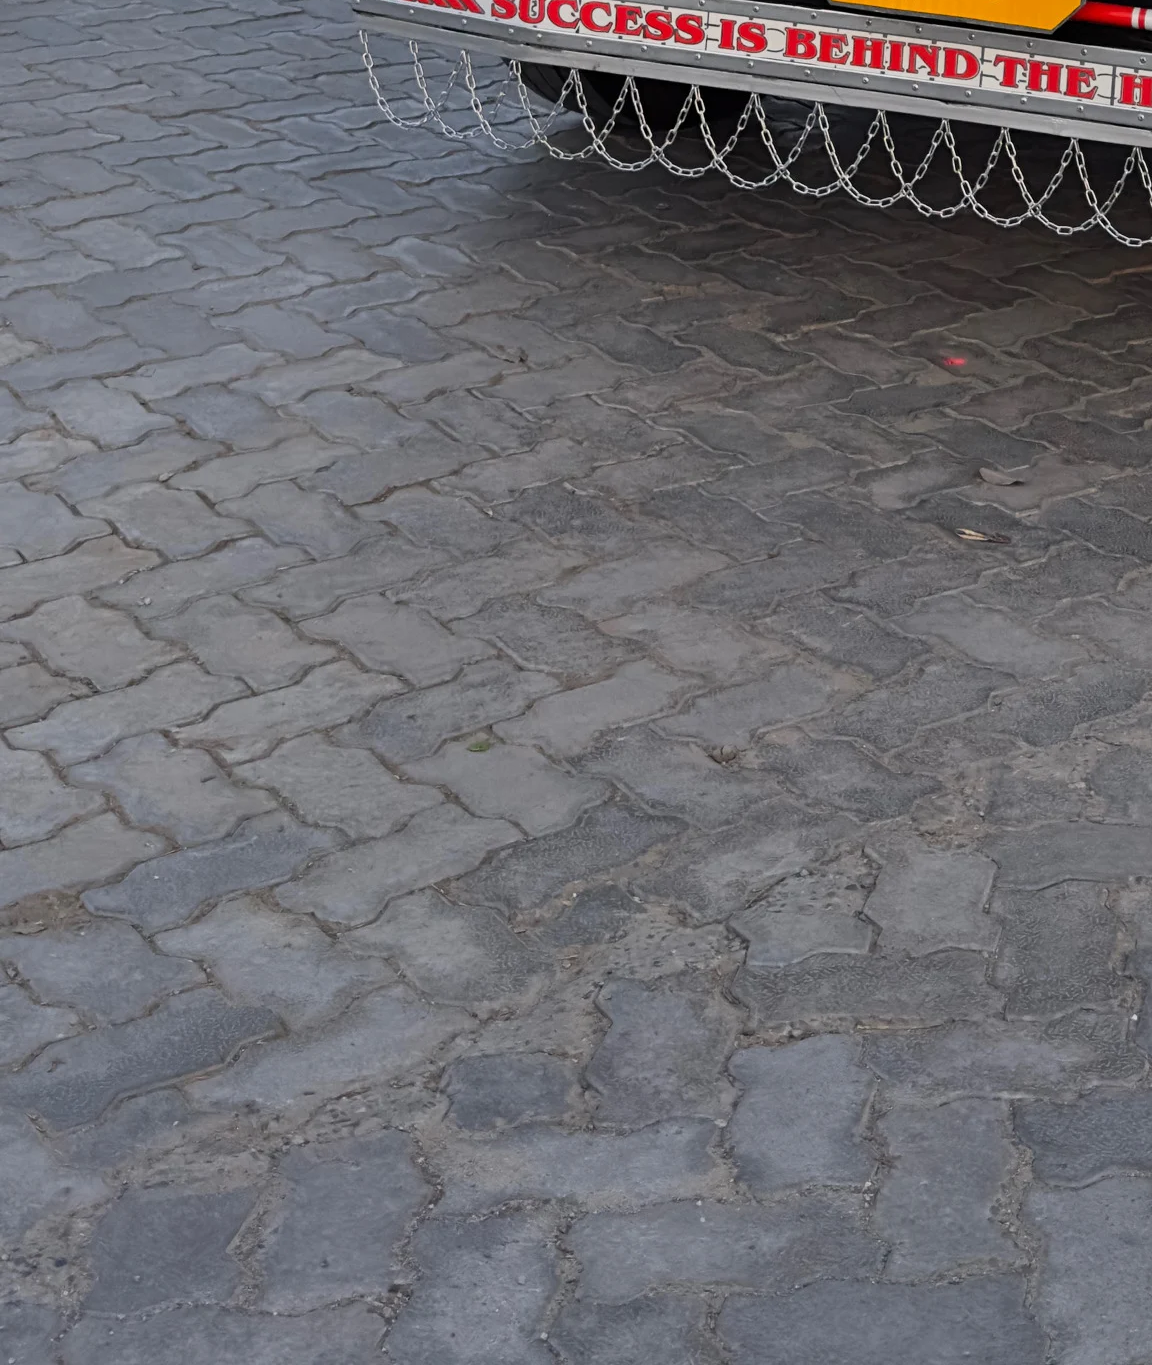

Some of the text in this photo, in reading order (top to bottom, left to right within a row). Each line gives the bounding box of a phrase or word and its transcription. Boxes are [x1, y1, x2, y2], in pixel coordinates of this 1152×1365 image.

[717, 18, 769, 54] IS
[783, 26, 981, 81] BEHIND
[993, 54, 1100, 101] THE
